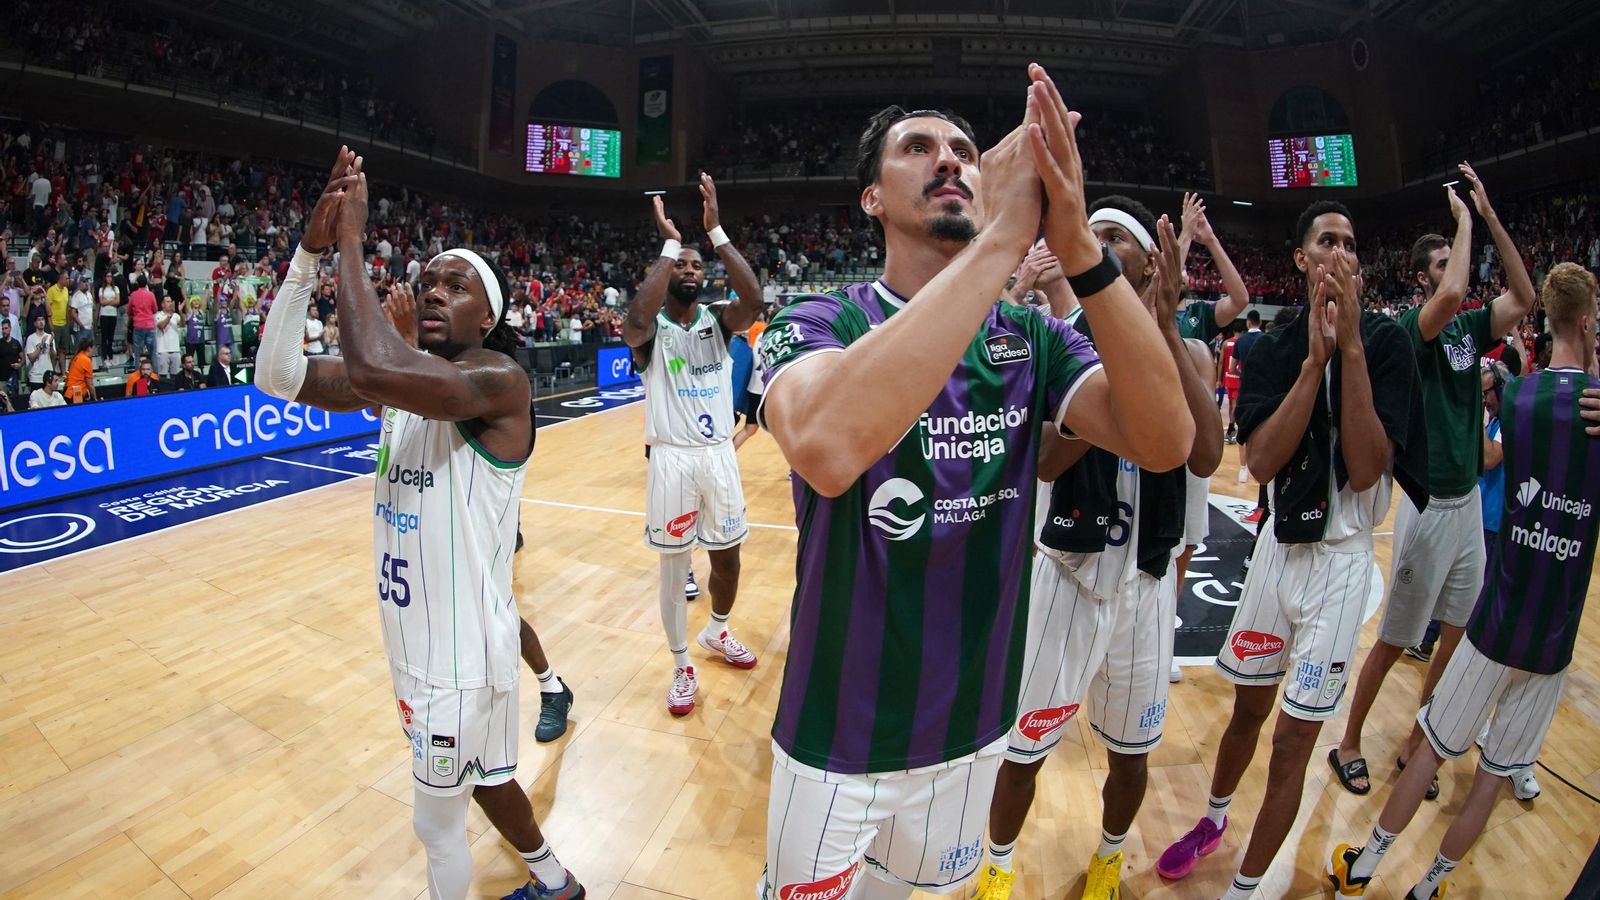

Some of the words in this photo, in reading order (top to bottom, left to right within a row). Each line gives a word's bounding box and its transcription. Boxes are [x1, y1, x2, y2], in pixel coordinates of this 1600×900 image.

[990, 343, 1007, 352] liga
[993, 348, 1028, 359] endesa
[159, 395, 331, 459] endesa
[698, 414, 714, 438] 3
[919, 405, 1028, 434] Fundación
[921, 434, 1005, 463] Unicaja
[98, 497, 141, 508] Costa
[143, 486, 187, 498] Cálida
[107, 484, 225, 516] REGIÓN
[119, 506, 168, 523] DE
[169, 479, 290, 510] MURCIA
[934, 497, 978, 510] COSTA
[997, 488, 1020, 500] SOL
[1542, 491, 1592, 520] Unicaja
[934, 510, 986, 524] MÁLAGA
[1053, 516, 1075, 528] acb
[1301, 509, 1323, 520] acb
[1511, 521, 1582, 561] málaga
[379, 552, 411, 608] 55
[1232, 631, 1282, 650] famadesa
[1301, 661, 1324, 678] má
